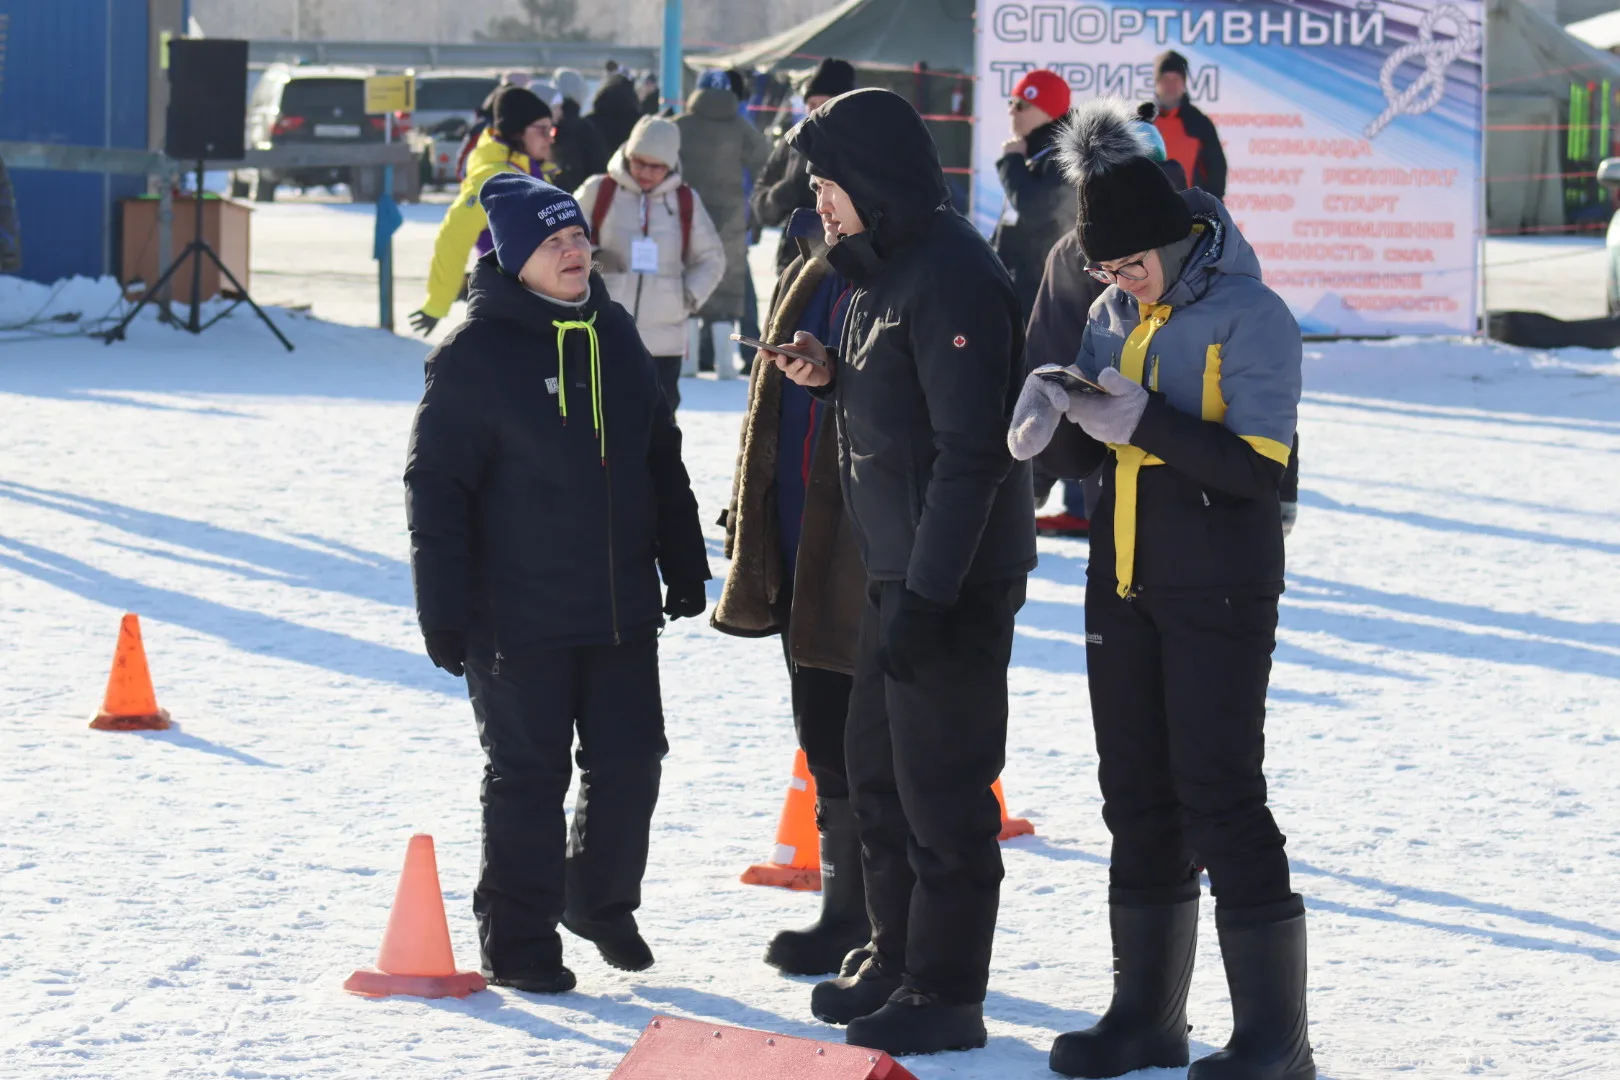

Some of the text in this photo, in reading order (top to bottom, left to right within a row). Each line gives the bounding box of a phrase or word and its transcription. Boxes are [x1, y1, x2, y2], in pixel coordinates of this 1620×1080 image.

[993, 1, 1387, 46] СПОРТИВНЫЙ
[990, 60, 1219, 102] ТРИЗМ
[1249, 138, 1373, 158] КОМАНДА
[1228, 168, 1459, 187] ИОНАТ РЕЗУЛЬТАТ
[537, 199, 576, 220] ОБСТАНОВКА
[1322, 193, 1400, 213] СТАРТ
[545, 208, 578, 227] ПО КАЙФУ
[1292, 220, 1456, 239] СТРЕМЛЕНИЕ
[1252, 241, 1375, 262] РЕННОСТЬ
[1341, 295, 1459, 312] СКОРОСТЬ
